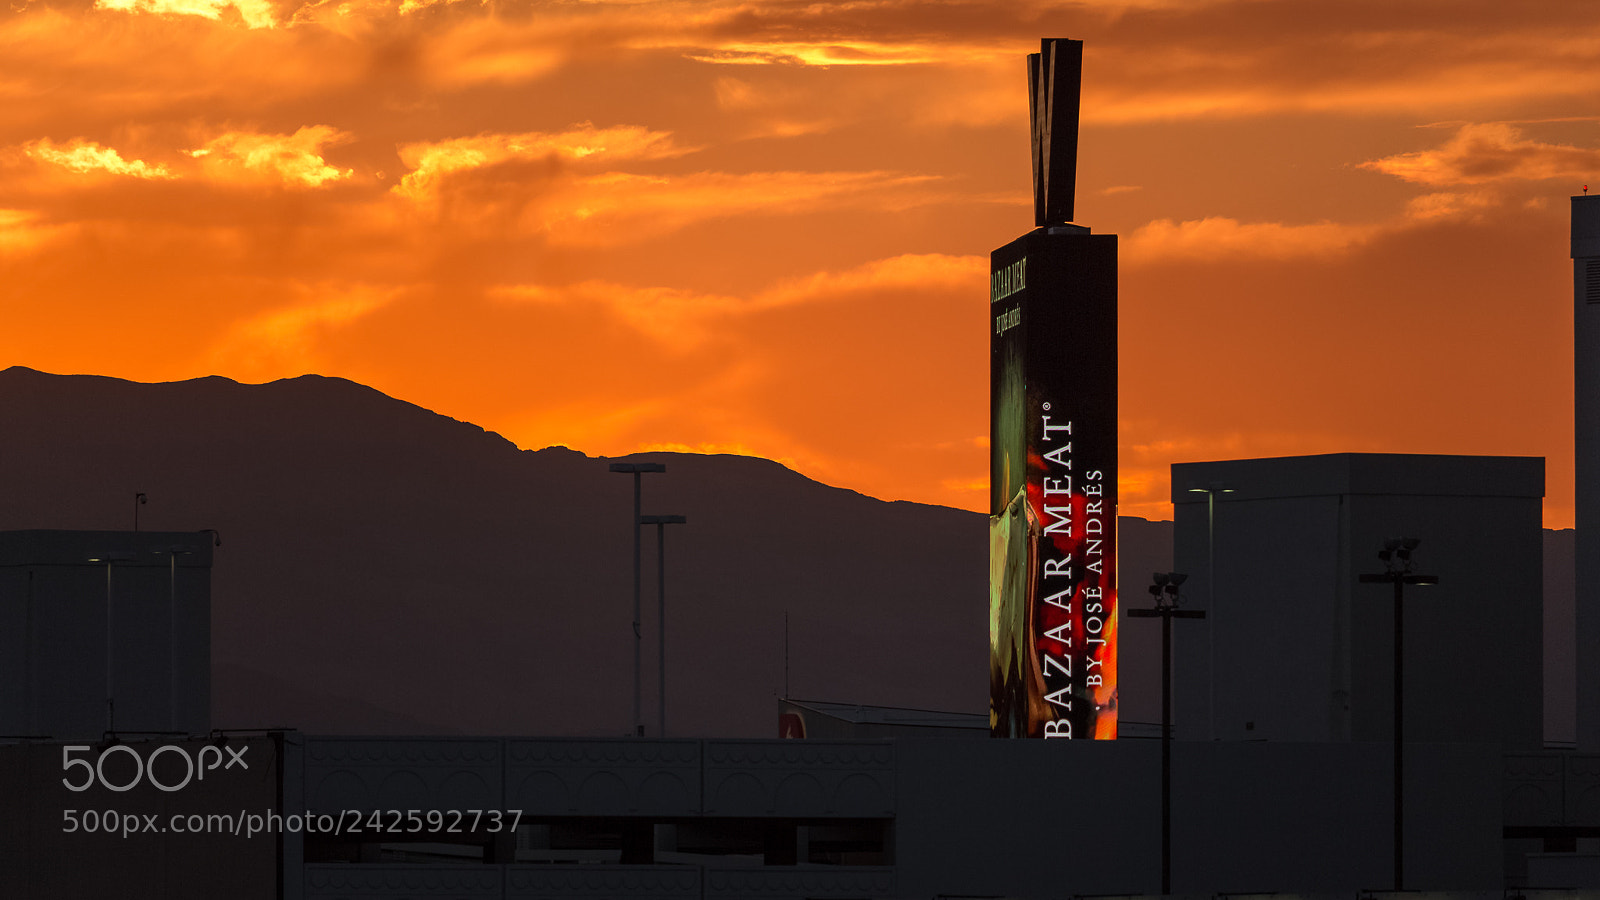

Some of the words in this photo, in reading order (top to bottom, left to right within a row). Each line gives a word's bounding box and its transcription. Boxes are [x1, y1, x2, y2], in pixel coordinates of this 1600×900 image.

[1082, 469, 1103, 575] ANDRÉS
[1043, 553, 1072, 740] BAZAAR
[1082, 585, 1106, 646] JOSÉ
[1086, 655, 1103, 688] BY
